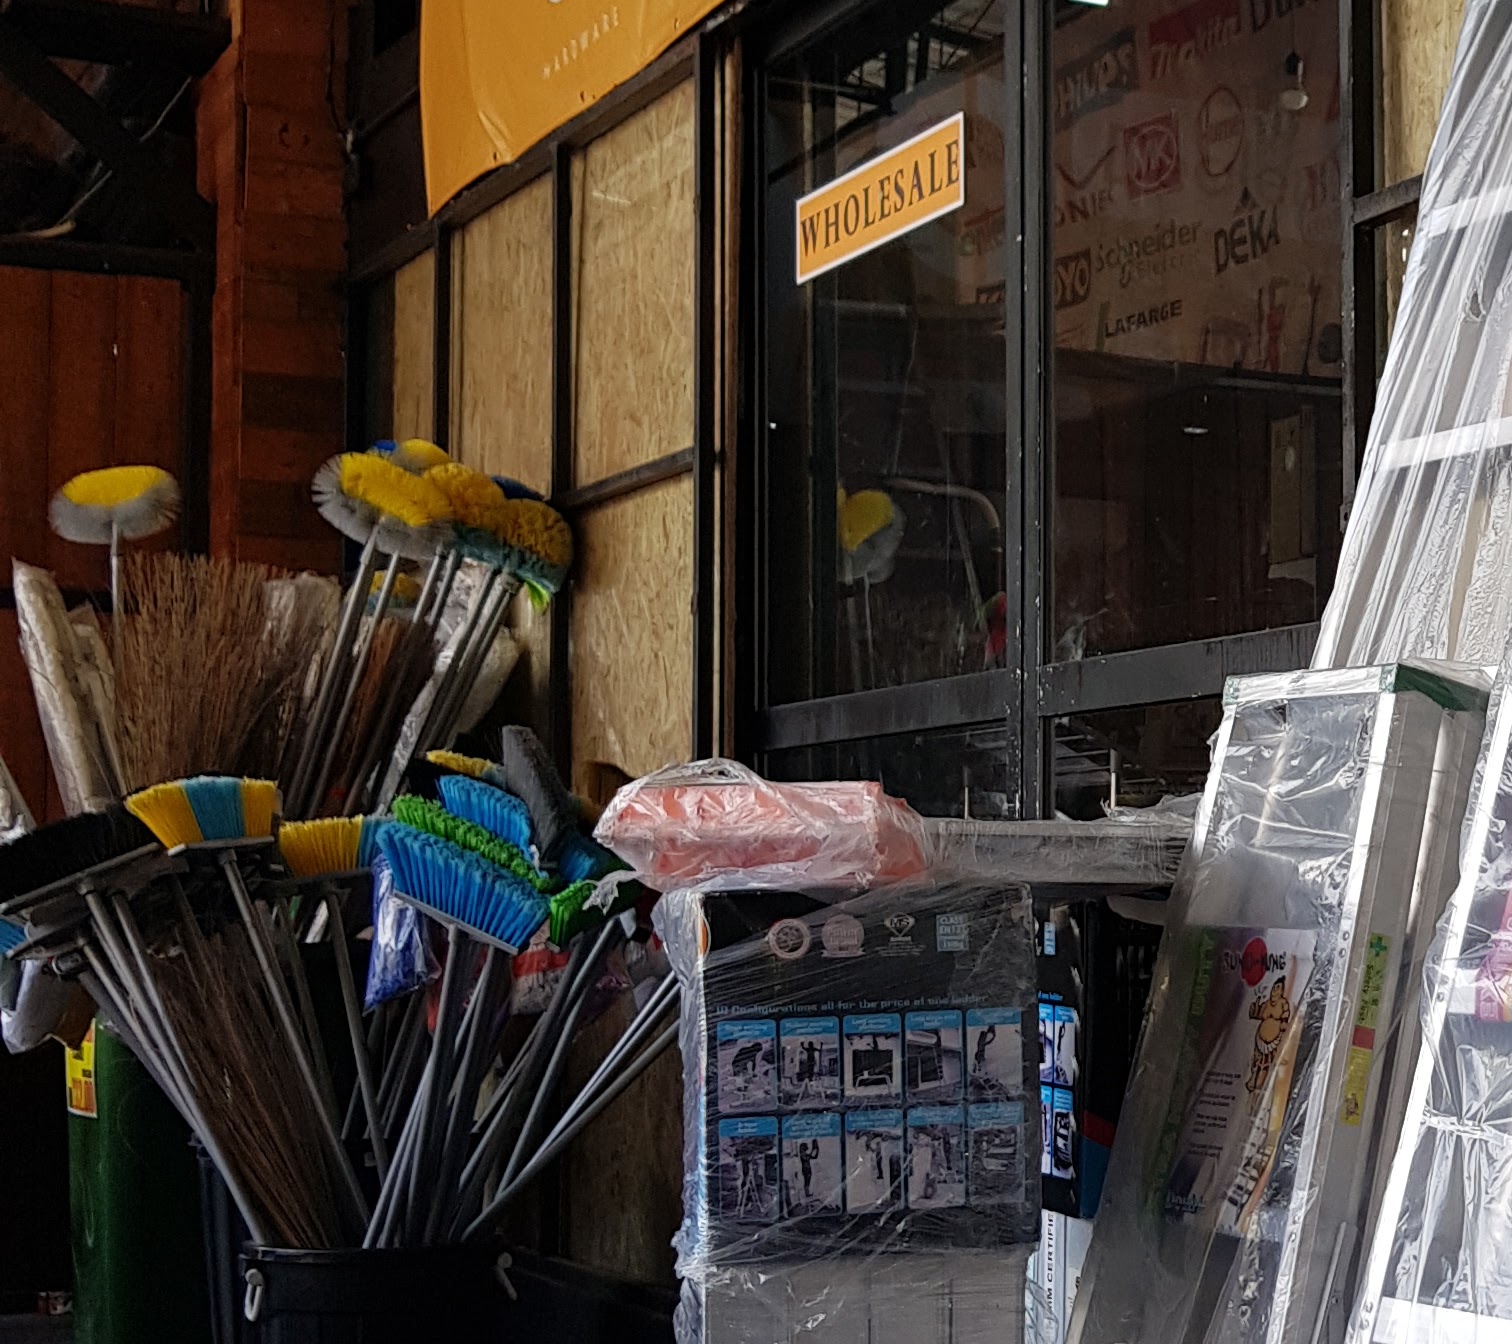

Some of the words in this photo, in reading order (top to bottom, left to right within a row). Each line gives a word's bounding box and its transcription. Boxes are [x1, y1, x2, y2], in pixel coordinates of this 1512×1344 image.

[800, 138, 961, 258] WHOLESALE
[1213, 205, 1280, 279] DEKA
[1105, 299, 1183, 339] LAFARGE
[821, 1000, 834, 1009] all
[859, 999, 877, 1008] the
[881, 998, 910, 1009] price
